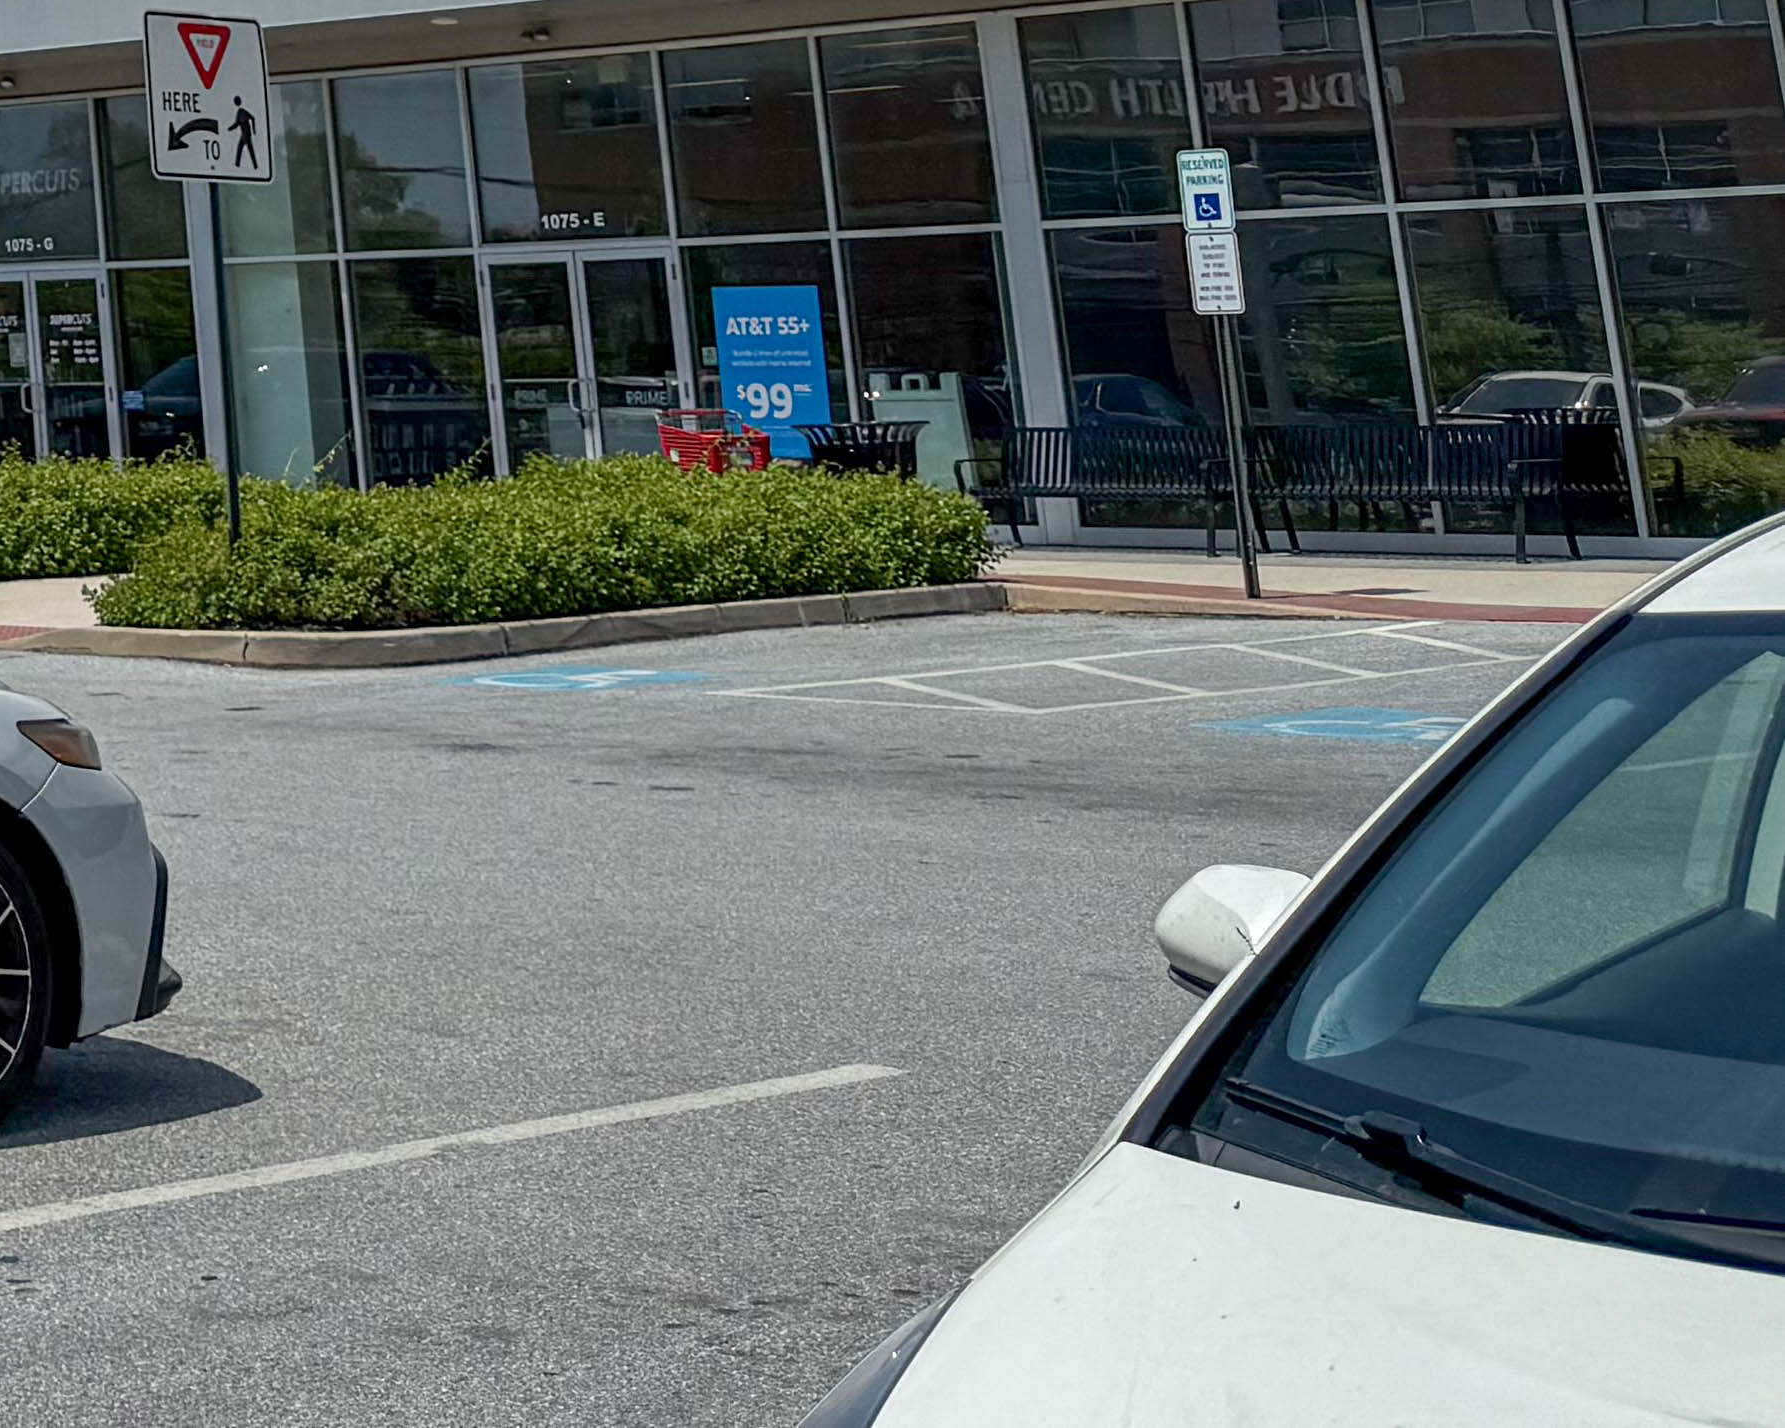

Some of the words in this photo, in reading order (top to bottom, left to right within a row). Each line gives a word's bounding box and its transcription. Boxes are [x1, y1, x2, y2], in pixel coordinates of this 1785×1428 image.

[162, 91, 202, 113] HERE
[203, 139, 221, 161] TO
[1181, 158, 1225, 172] RESERVED
[1185, 174, 1225, 186] PARKING
[541, 213, 580, 230] 1075
[593, 211, 606, 227] E
[5, 238, 34, 252] 1075
[43, 236, 55, 251] G
[725, 316, 774, 336] AT&T
[777, 315, 810, 335] 55+
